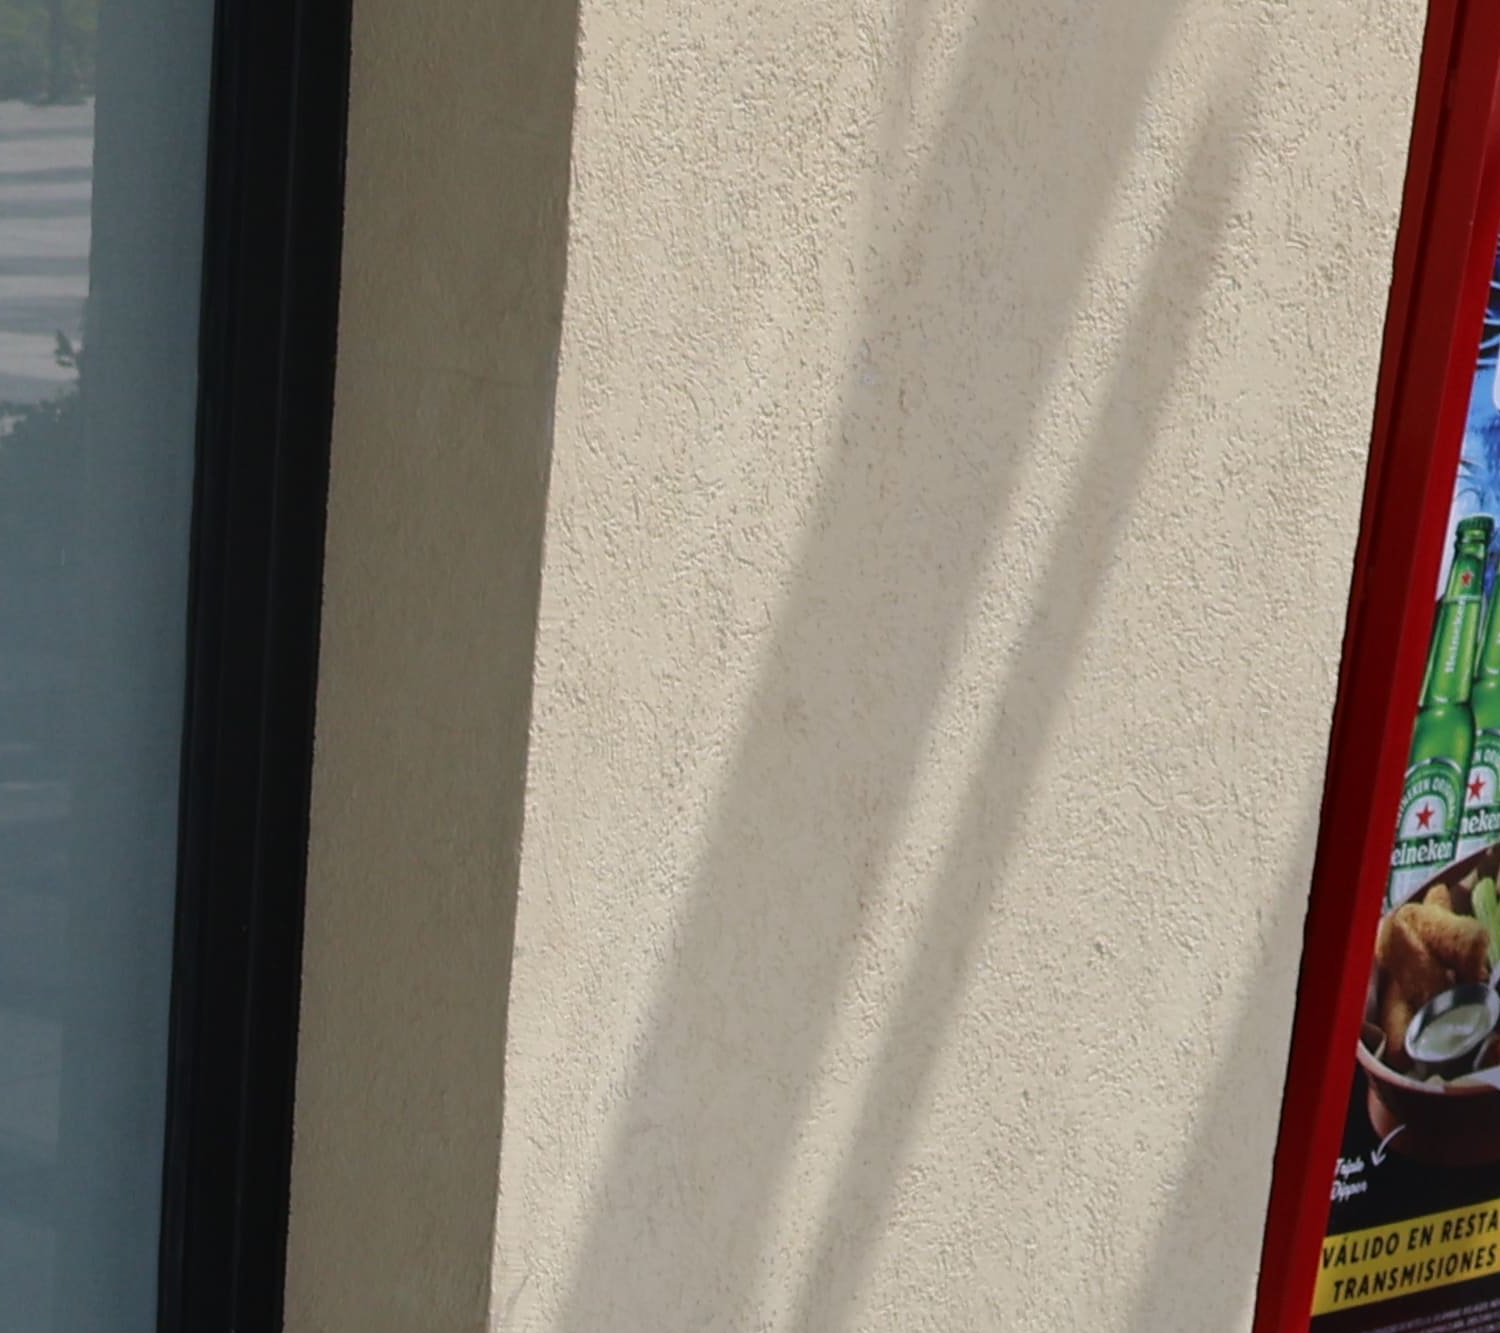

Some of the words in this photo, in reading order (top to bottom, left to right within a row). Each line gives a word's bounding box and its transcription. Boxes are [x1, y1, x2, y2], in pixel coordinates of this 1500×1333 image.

[1390, 839, 1453, 866] eineken
[1322, 1232, 1400, 1269] VÁLIDO
[1407, 1223, 1434, 1251] EN
[1333, 1243, 1497, 1302] TRANSMISIONES
